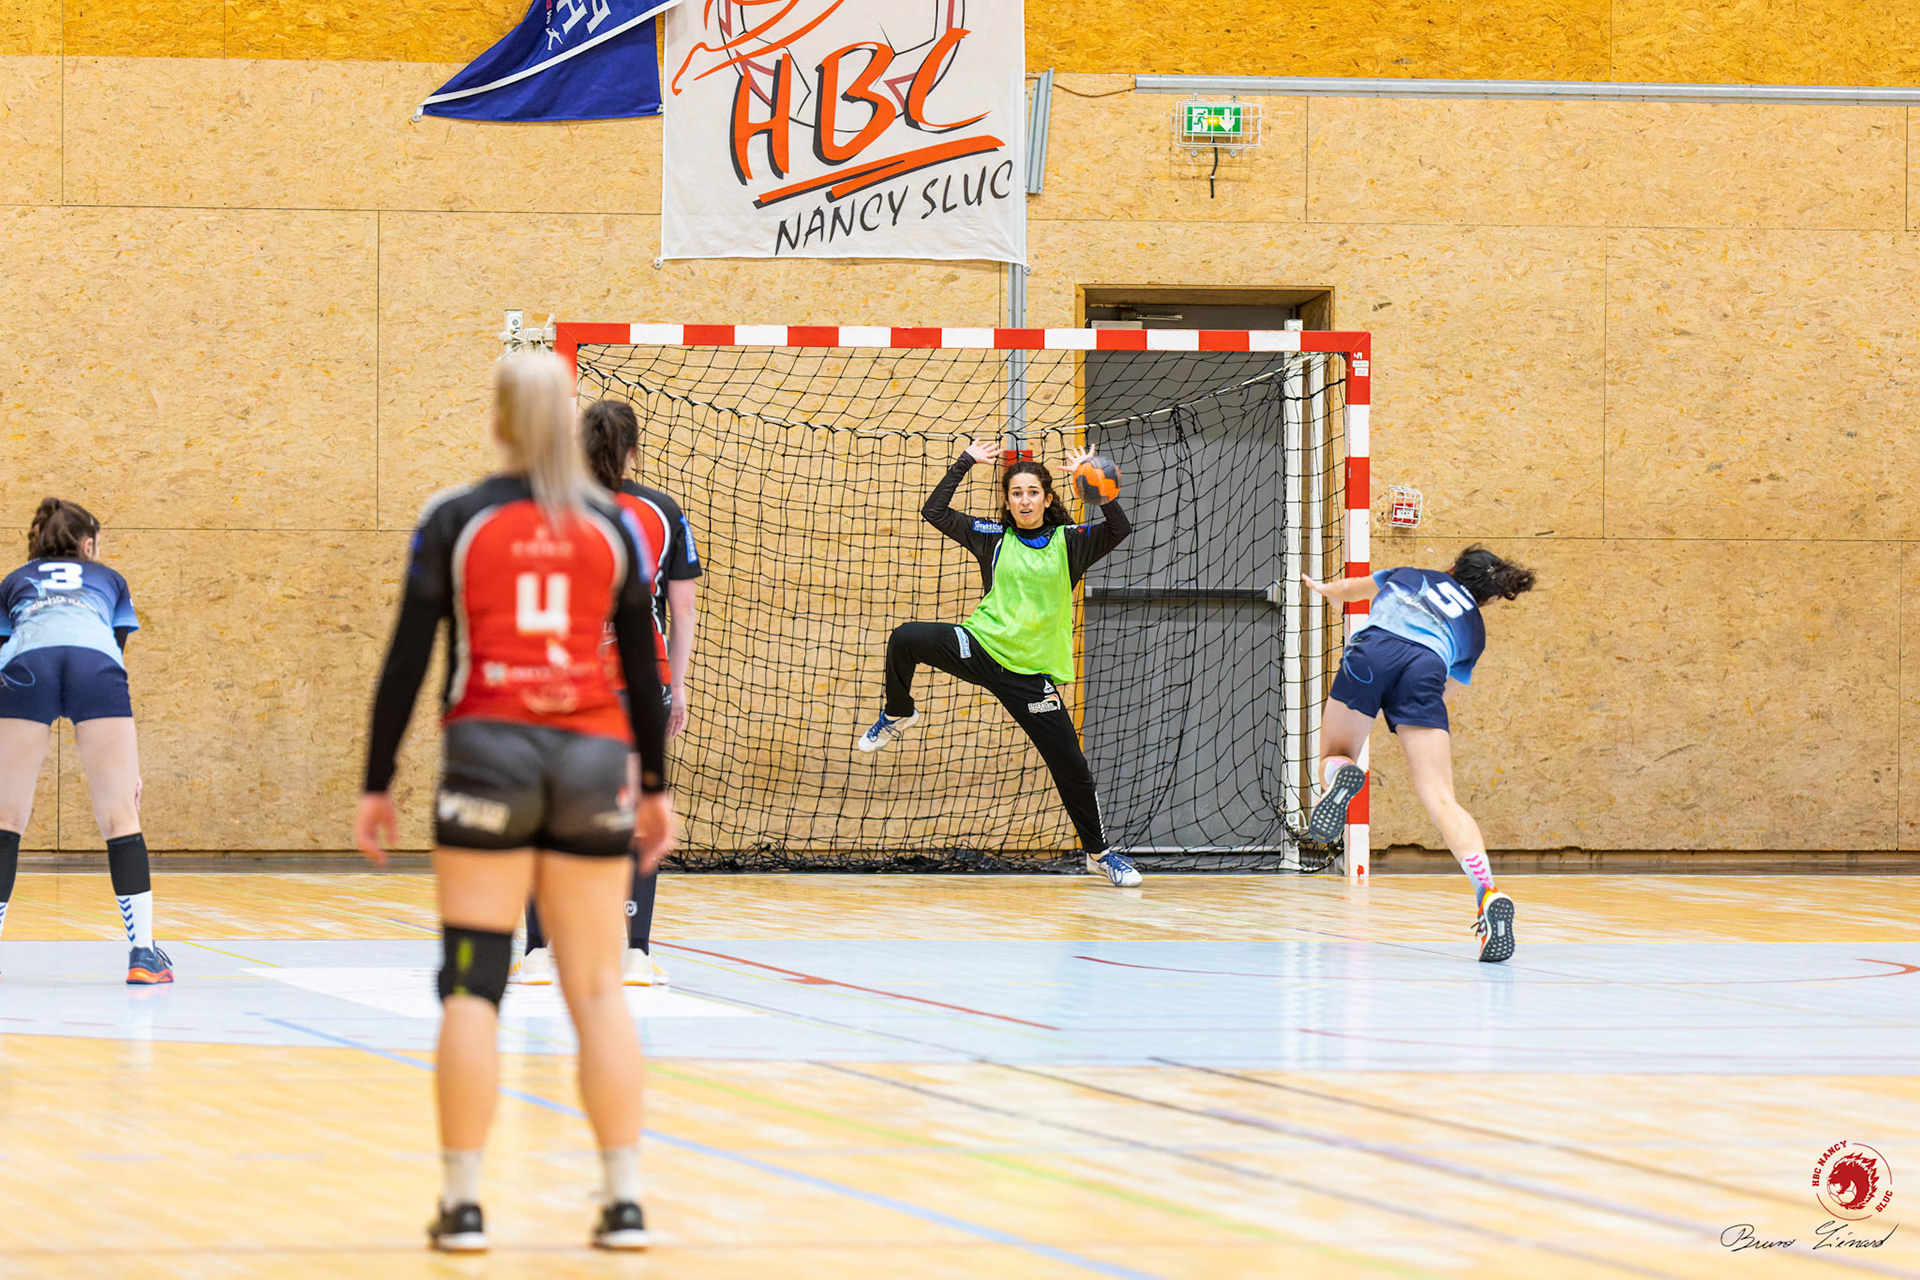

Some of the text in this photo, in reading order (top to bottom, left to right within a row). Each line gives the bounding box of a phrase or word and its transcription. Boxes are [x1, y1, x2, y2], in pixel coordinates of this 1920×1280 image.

[729, 28, 994, 186] HBC
[775, 159, 1013, 256] NANCY SLUC
[38, 562, 83, 590] 3
[516, 571, 571, 638] 4
[1426, 581, 1474, 619] 5
